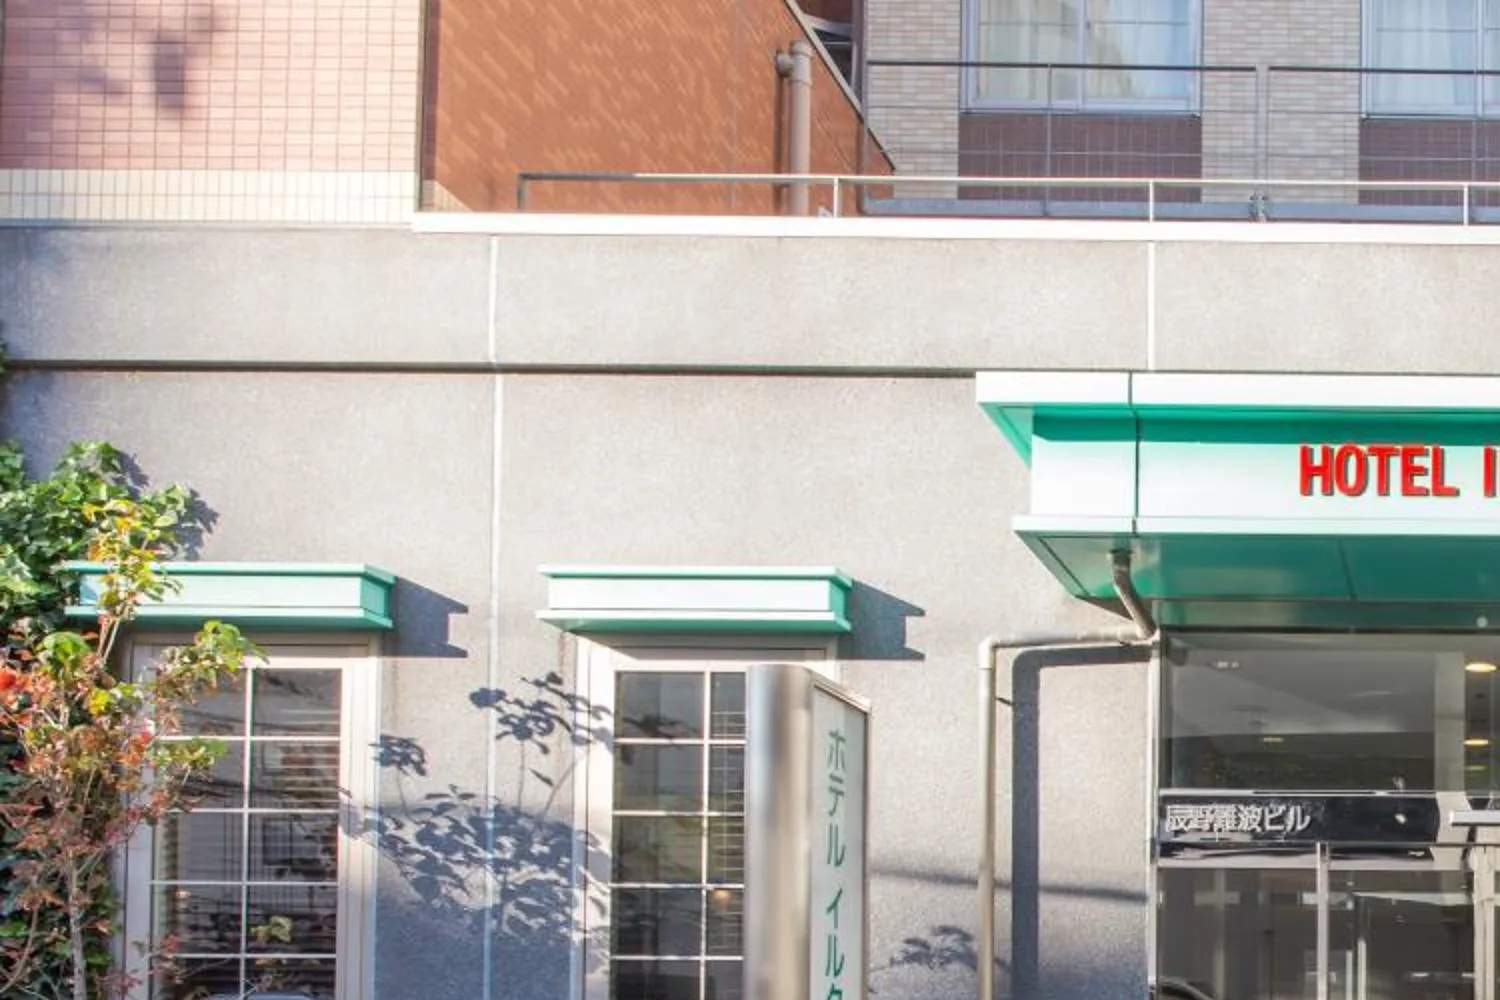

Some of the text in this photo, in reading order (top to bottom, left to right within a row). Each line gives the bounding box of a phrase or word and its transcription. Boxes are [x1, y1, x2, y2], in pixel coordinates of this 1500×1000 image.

[1299, 444, 1460, 497] HOTEL
[827, 729, 846, 867] ホテル
[1166, 804, 1310, 833] 辰野難波ビル
